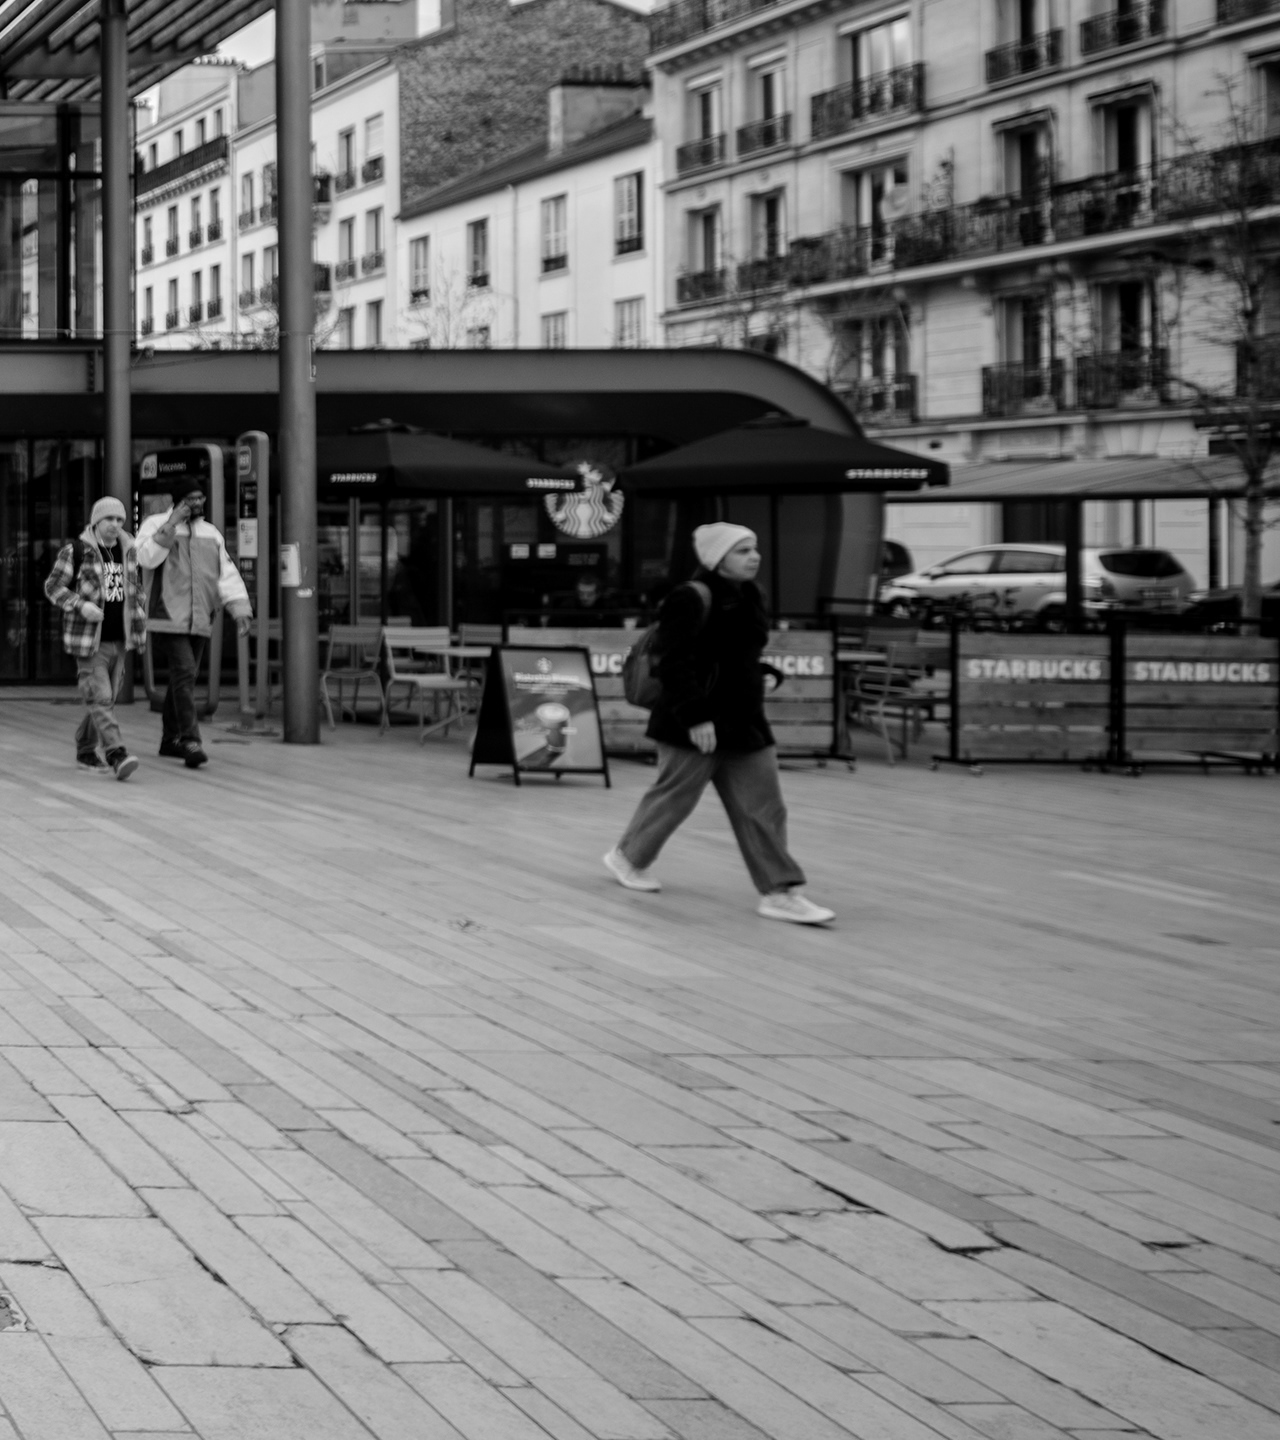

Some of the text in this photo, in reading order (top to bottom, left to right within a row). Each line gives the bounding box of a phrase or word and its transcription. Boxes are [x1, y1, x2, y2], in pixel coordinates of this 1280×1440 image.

[330, 473, 377, 483] STARBUCKS
[844, 468, 929, 479] STARBUCKS
[526, 478, 575, 490] STARBUCKS
[967, 659, 1101, 680] STARBUCKS
[1134, 662, 1270, 682] STARBUCKS
